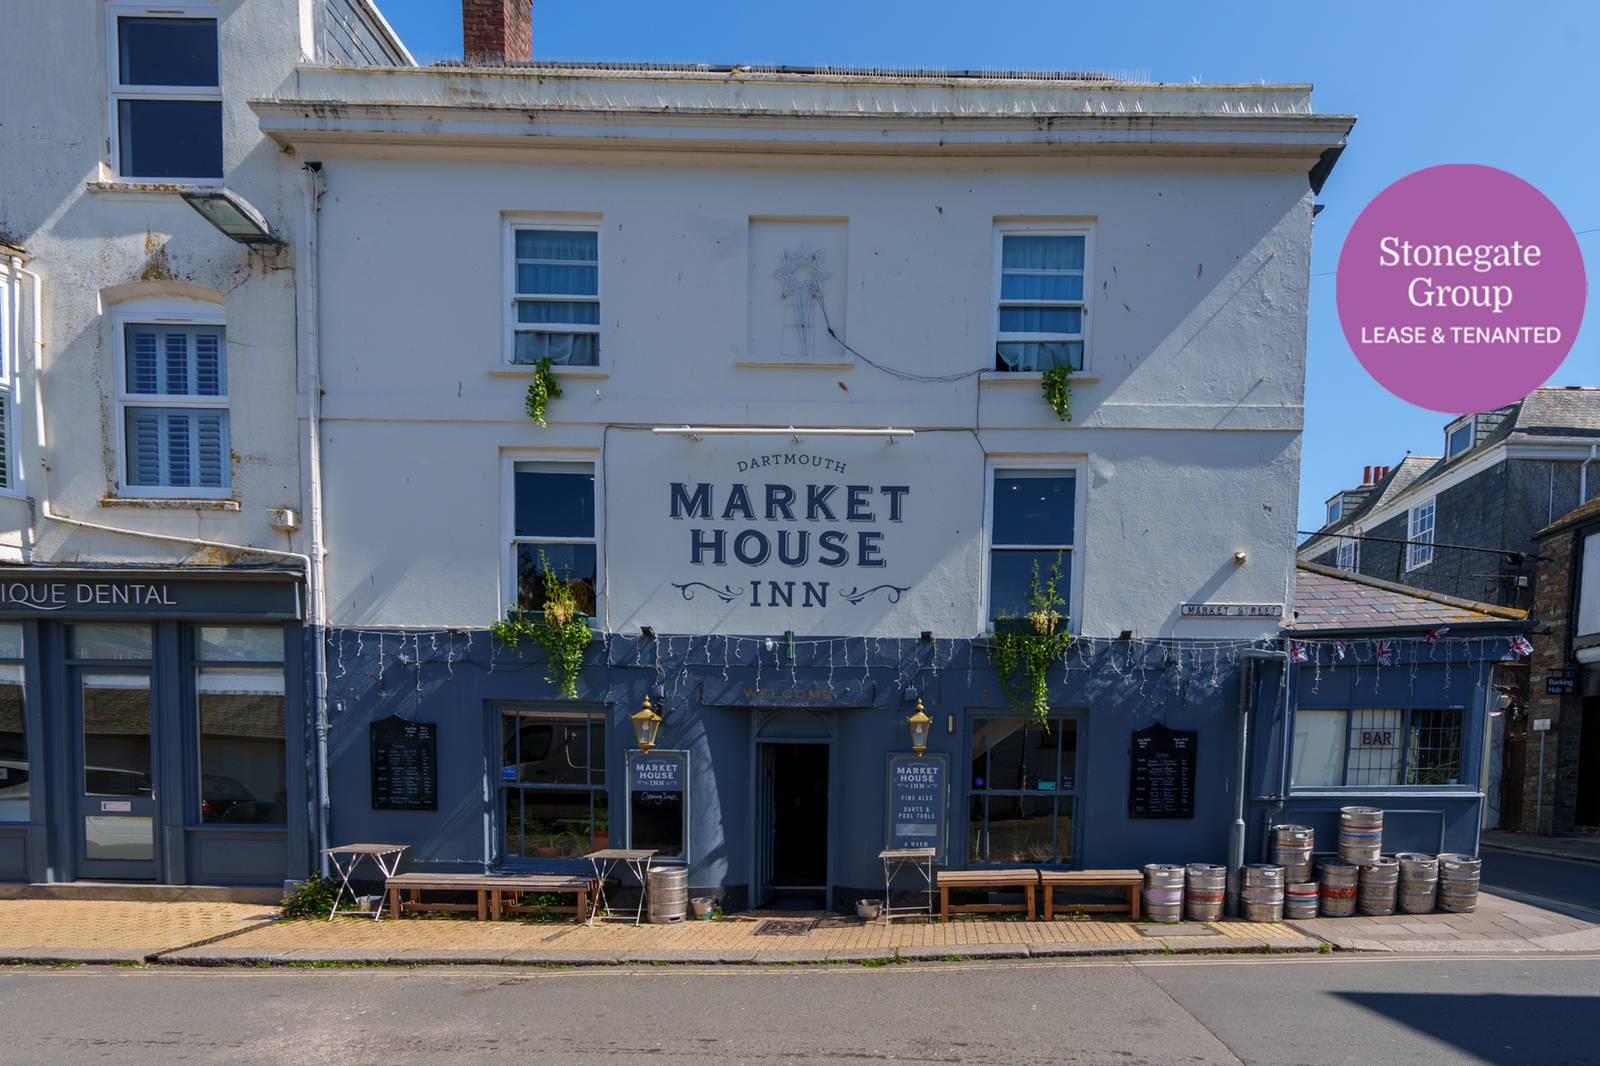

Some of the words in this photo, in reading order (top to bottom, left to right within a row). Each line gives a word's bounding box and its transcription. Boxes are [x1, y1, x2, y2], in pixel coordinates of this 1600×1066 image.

[736, 453, 848, 474] DARTMOUTH
[669, 482, 910, 522] MARKET
[689, 528, 887, 568] HOUSE
[1, 583, 67, 610] IQUE
[76, 583, 177, 605] DENTAL
[749, 580, 830, 608] INN
[1188, 605, 1229, 616] MARKET
[1238, 605, 1276, 616] STREET
[744, 688, 832, 700] WELCOME
[1363, 731, 1392, 745] BAR
[900, 774, 935, 782] HOUSE
